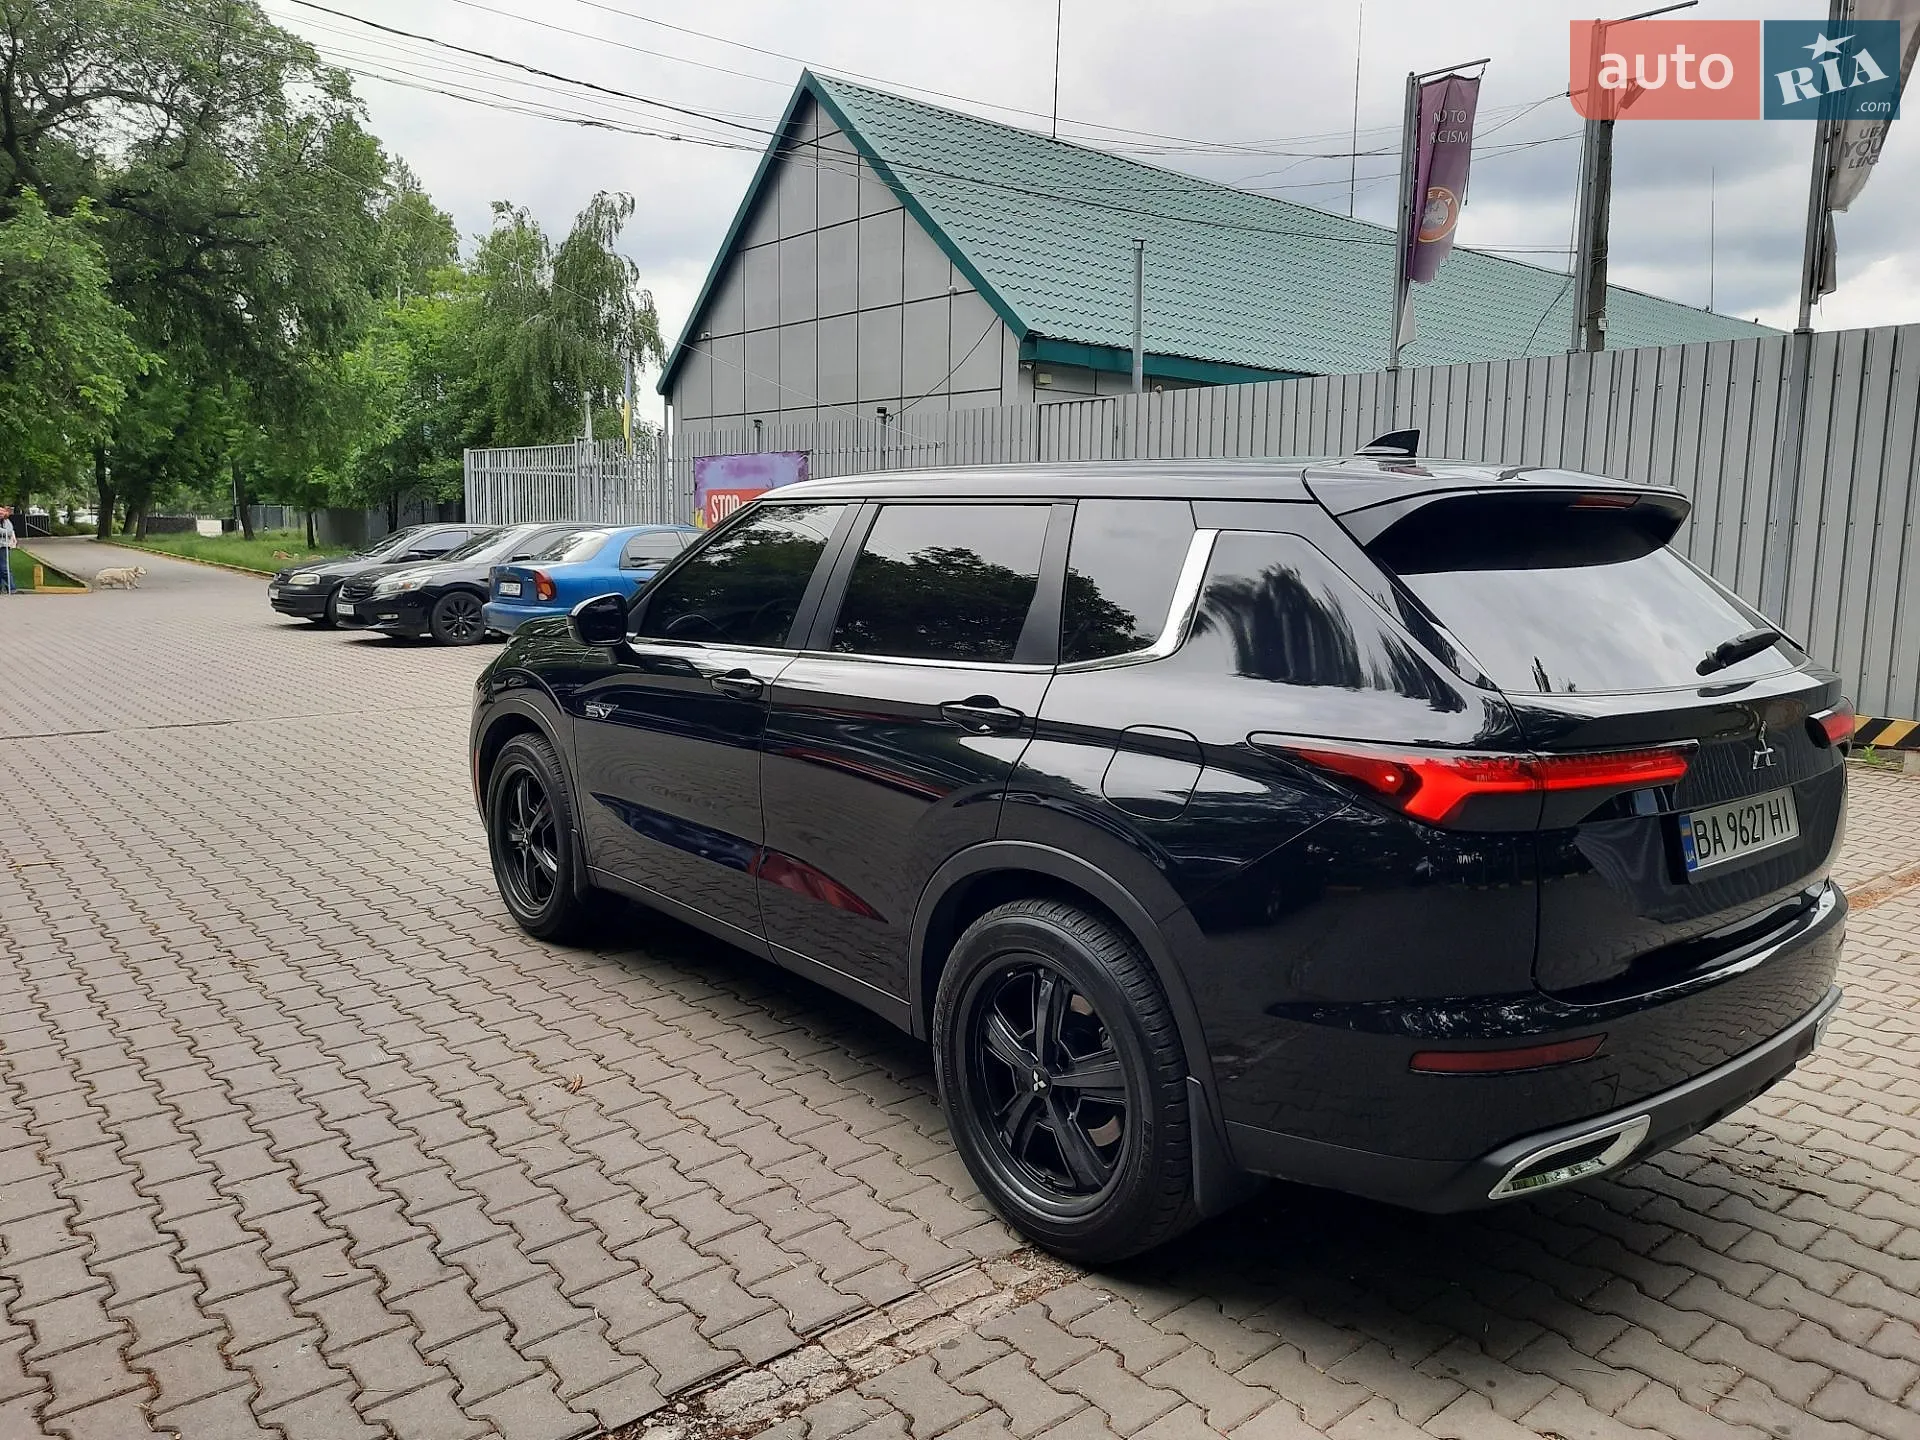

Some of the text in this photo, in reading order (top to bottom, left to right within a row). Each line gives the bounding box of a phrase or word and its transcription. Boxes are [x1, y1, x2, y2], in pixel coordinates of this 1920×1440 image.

[1433, 110, 1467, 124] NO TO
[1430, 130, 1469, 145] RCISM
[711, 494, 740, 523] STOP
[1693, 796, 1791, 860] BA 9627 HI
